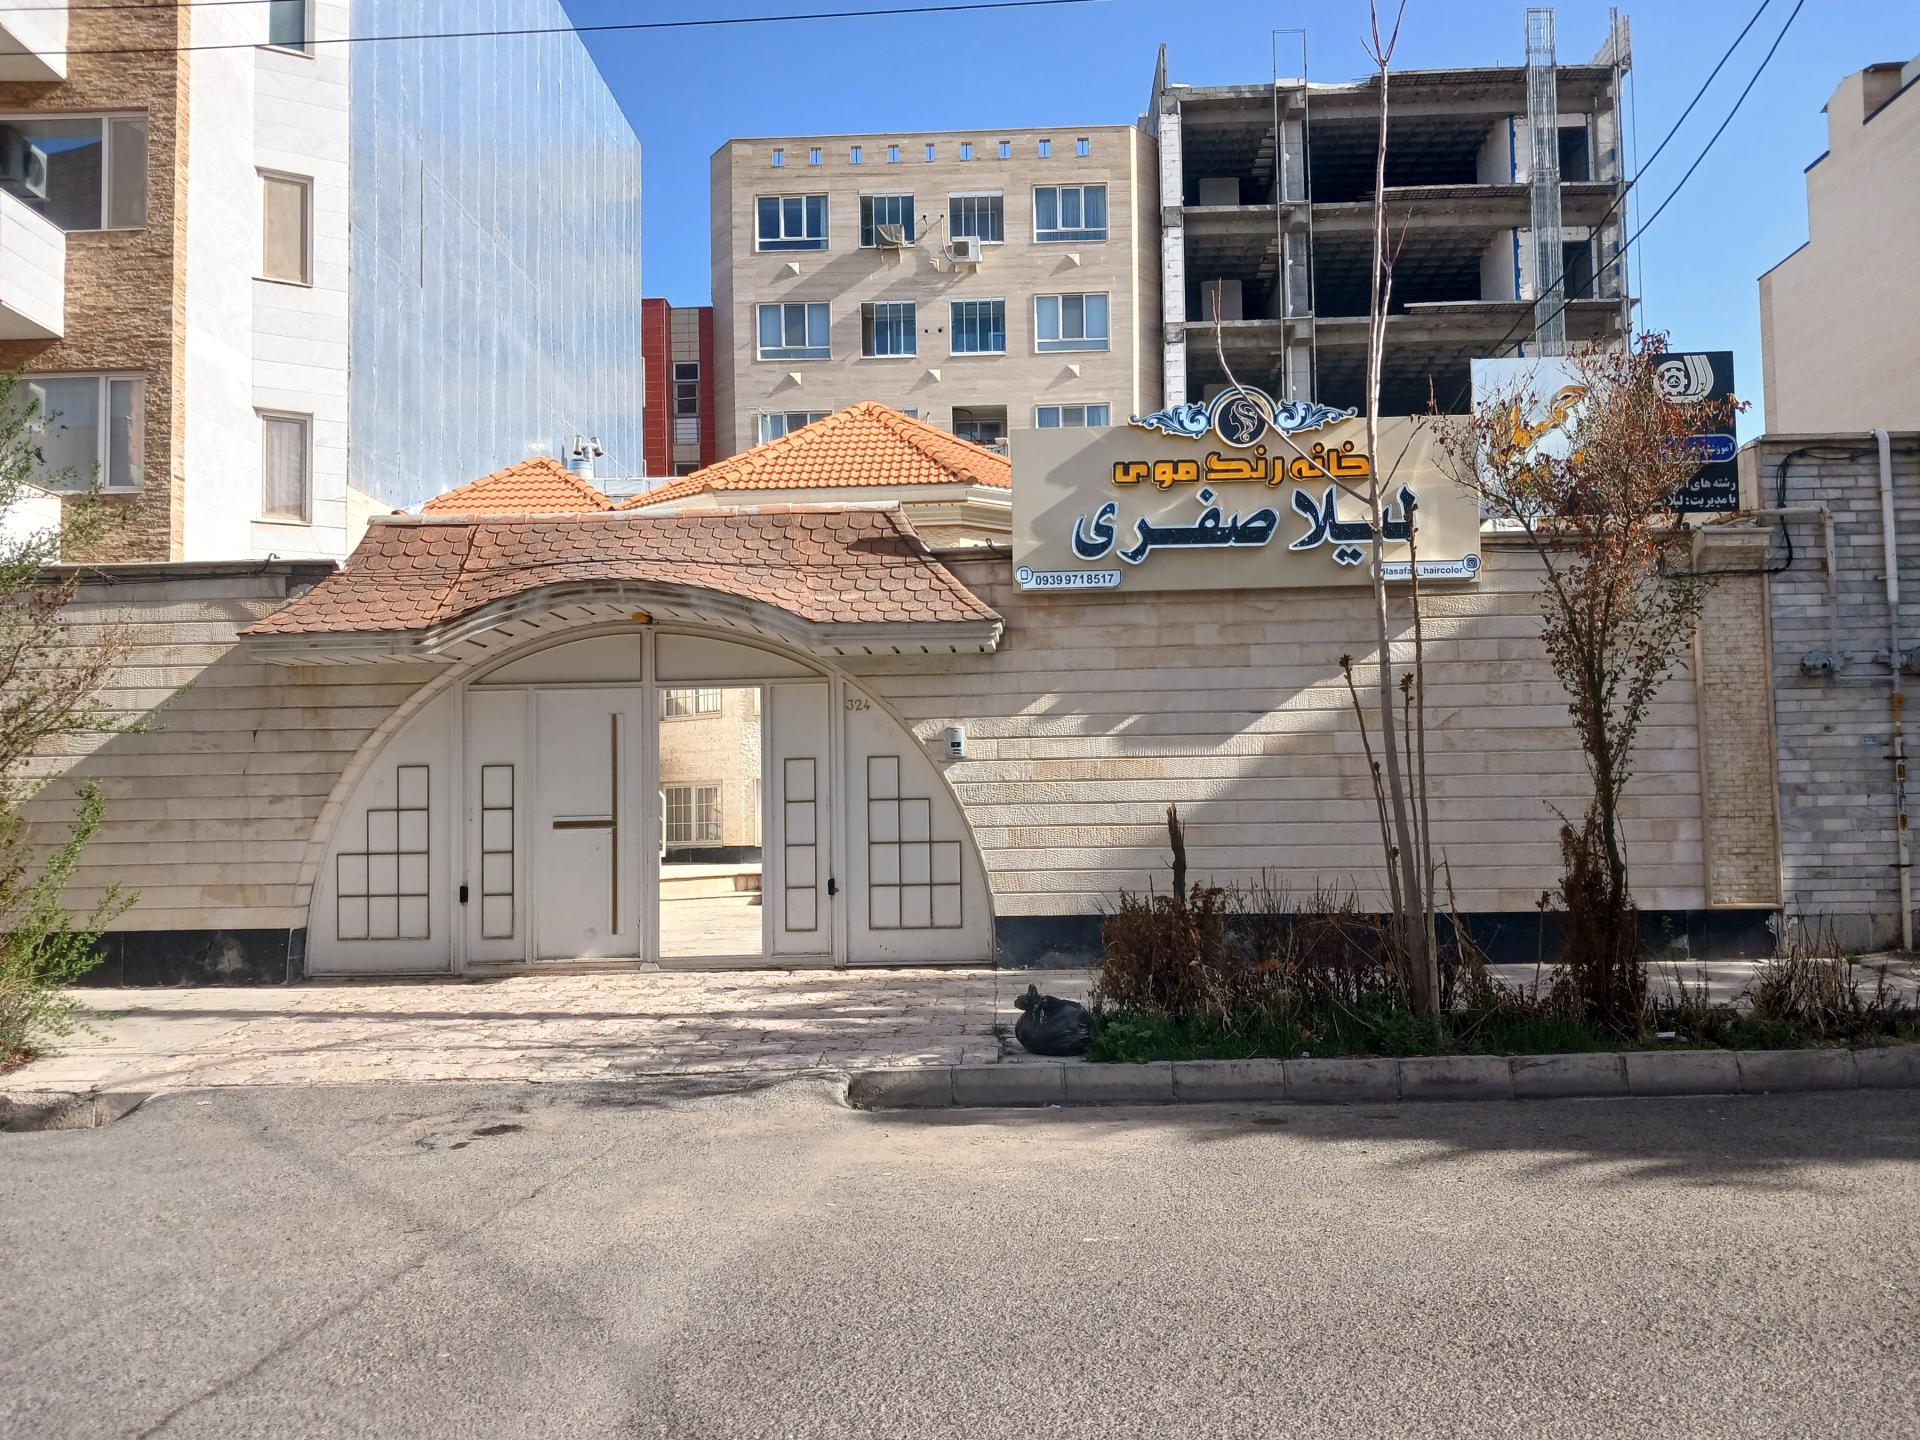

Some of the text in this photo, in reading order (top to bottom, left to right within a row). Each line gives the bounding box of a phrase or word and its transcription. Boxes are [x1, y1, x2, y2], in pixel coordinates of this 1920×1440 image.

[1289, 440, 1370, 481] خانه
[1690, 477, 1711, 491] های
[1712, 477, 1736, 491] رشته
[1071, 482, 1420, 566] لیلا صفری
[846, 699, 871, 711] 324
